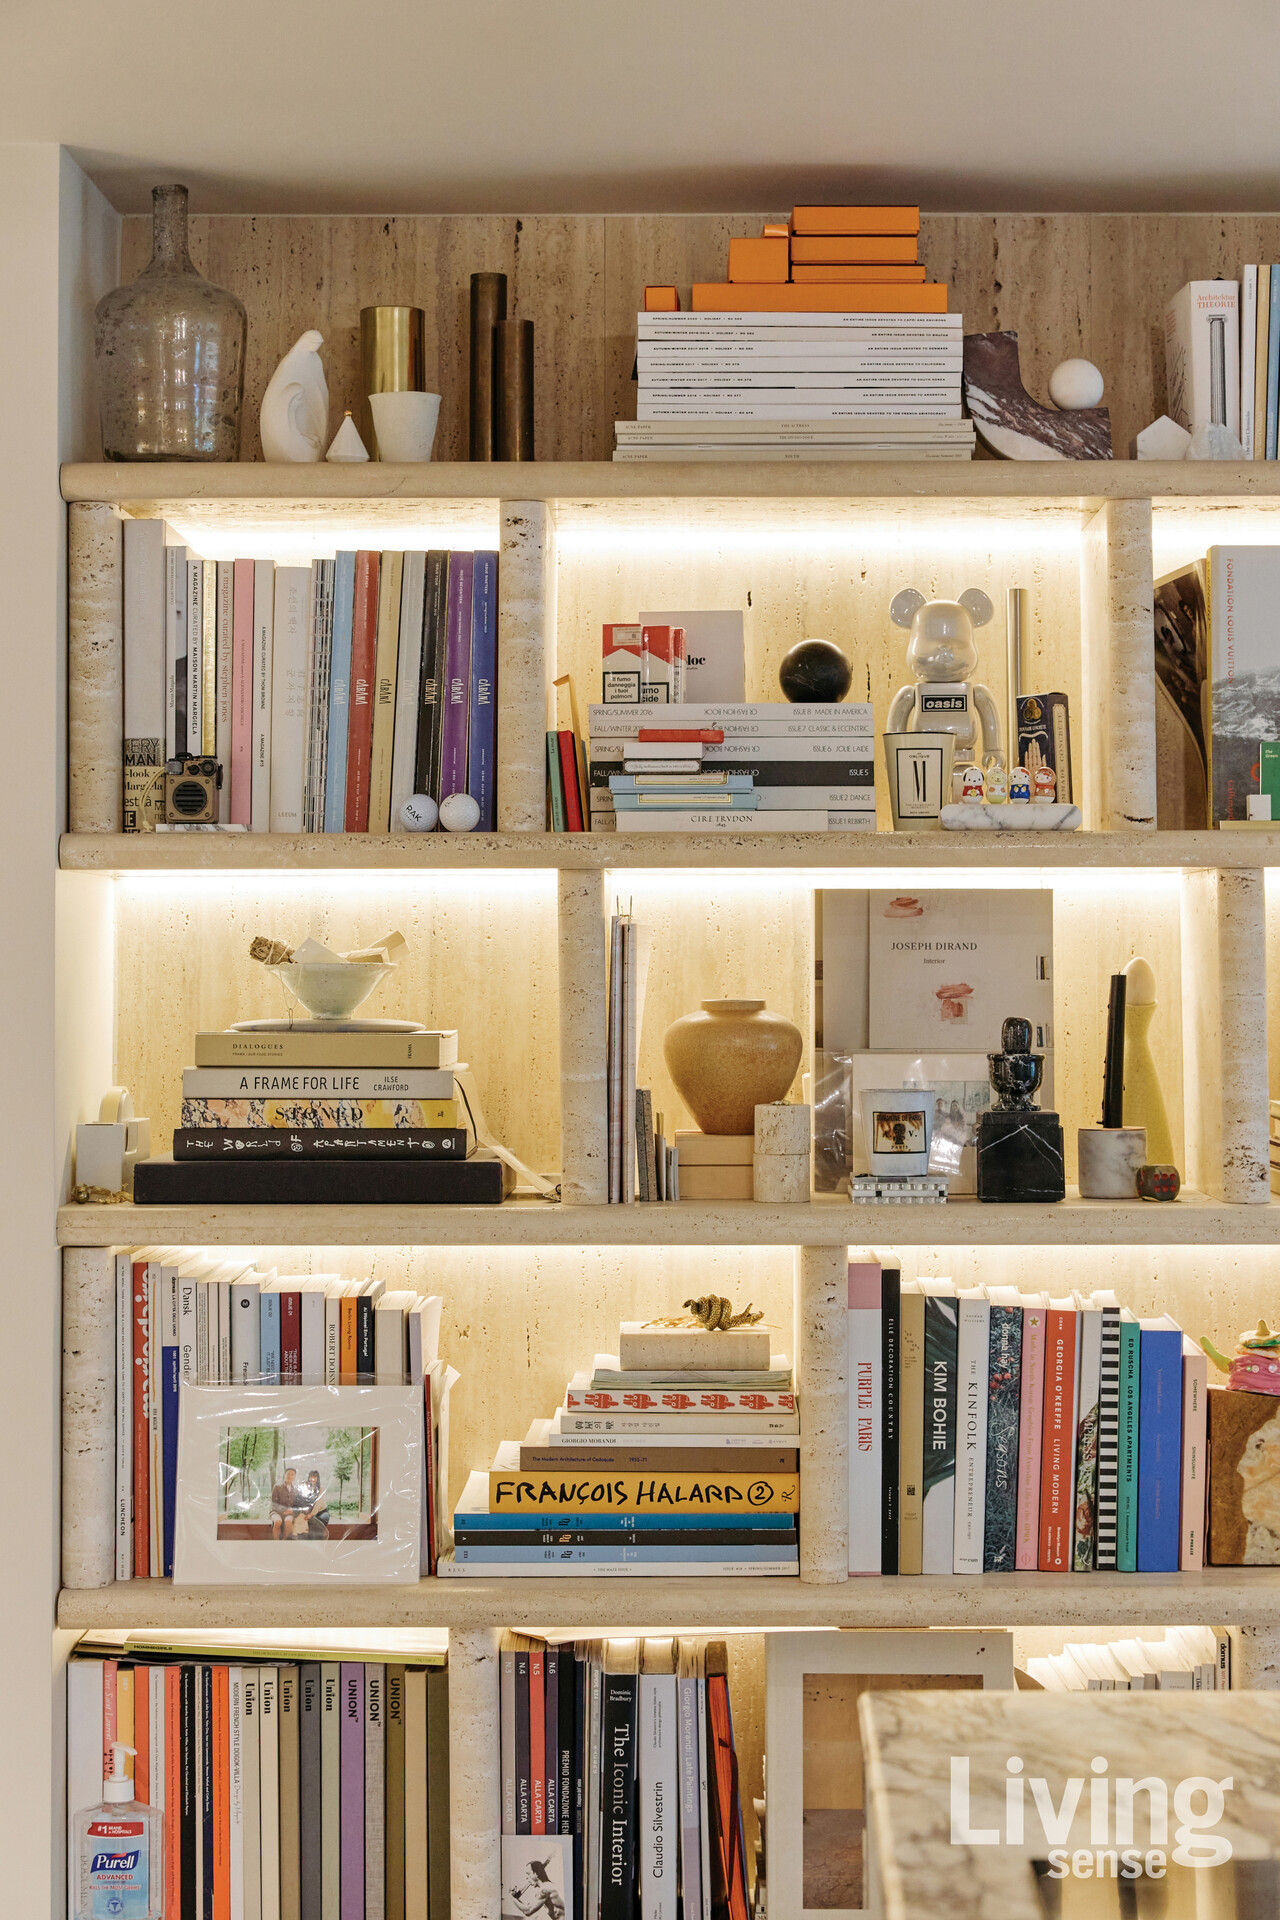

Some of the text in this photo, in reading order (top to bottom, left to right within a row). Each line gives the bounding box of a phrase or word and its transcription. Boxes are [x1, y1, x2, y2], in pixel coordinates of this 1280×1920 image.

[193, 637, 198, 646] BY
[222, 618, 230, 650] curated
[221, 652, 230, 662] by
[220, 666, 229, 698] stephen
[334, 678, 346, 705] CABANA
[356, 678, 369, 705] CABANA
[379, 678, 392, 705] CABANA
[424, 678, 437, 705] CABANA
[450, 678, 464, 705] CABANA
[478, 678, 491, 705] CABANA
[926, 699, 963, 708] oasis
[125, 754, 156, 766] MAN
[913, 760, 926, 802] M
[891, 942, 977, 950] JOSEPH DIRAND
[240, 1077, 360, 1090] A FRAME FOR LIFE
[275, 1107, 363, 1120] STONED
[183, 1287, 192, 1316] Dansk
[1000, 1323, 1010, 1369] donna hay
[1128, 1338, 1134, 1348] ED
[183, 1345, 192, 1380] Gender
[858, 1362, 873, 1452] PURPLE PARIS
[933, 1361, 948, 1450] KIM BOHIE
[967, 1382, 978, 1451] KINFOLK
[1054, 1385, 1063, 1430] O'KEEFFE
[990, 1422, 1014, 1489] Seasons
[1053, 1438, 1061, 1471] LIVING
[495, 1480, 628, 1505] FRANÇOIS
[636, 1480, 743, 1505] HALARD
[1052, 1474, 1060, 1514] MODERN
[104, 1691, 113, 1710] Saint
[245, 1683, 256, 1716] Union
[264, 1682, 274, 1714] Union
[283, 1680, 293, 1712] Union
[305, 1679, 315, 1712] Union
[325, 1678, 336, 1711] Union
[683, 1687, 692, 1718] Giorgio
[104, 1712, 113, 1741] Laurent
[611, 1724, 630, 1886] The Iconic Interior
[685, 1776, 694, 1813] Paintings
[97, 1825, 107, 1834] #1
[652, 1781, 663, 1878] Claudio Silvestrin
[96, 1855, 135, 1869] Purell
